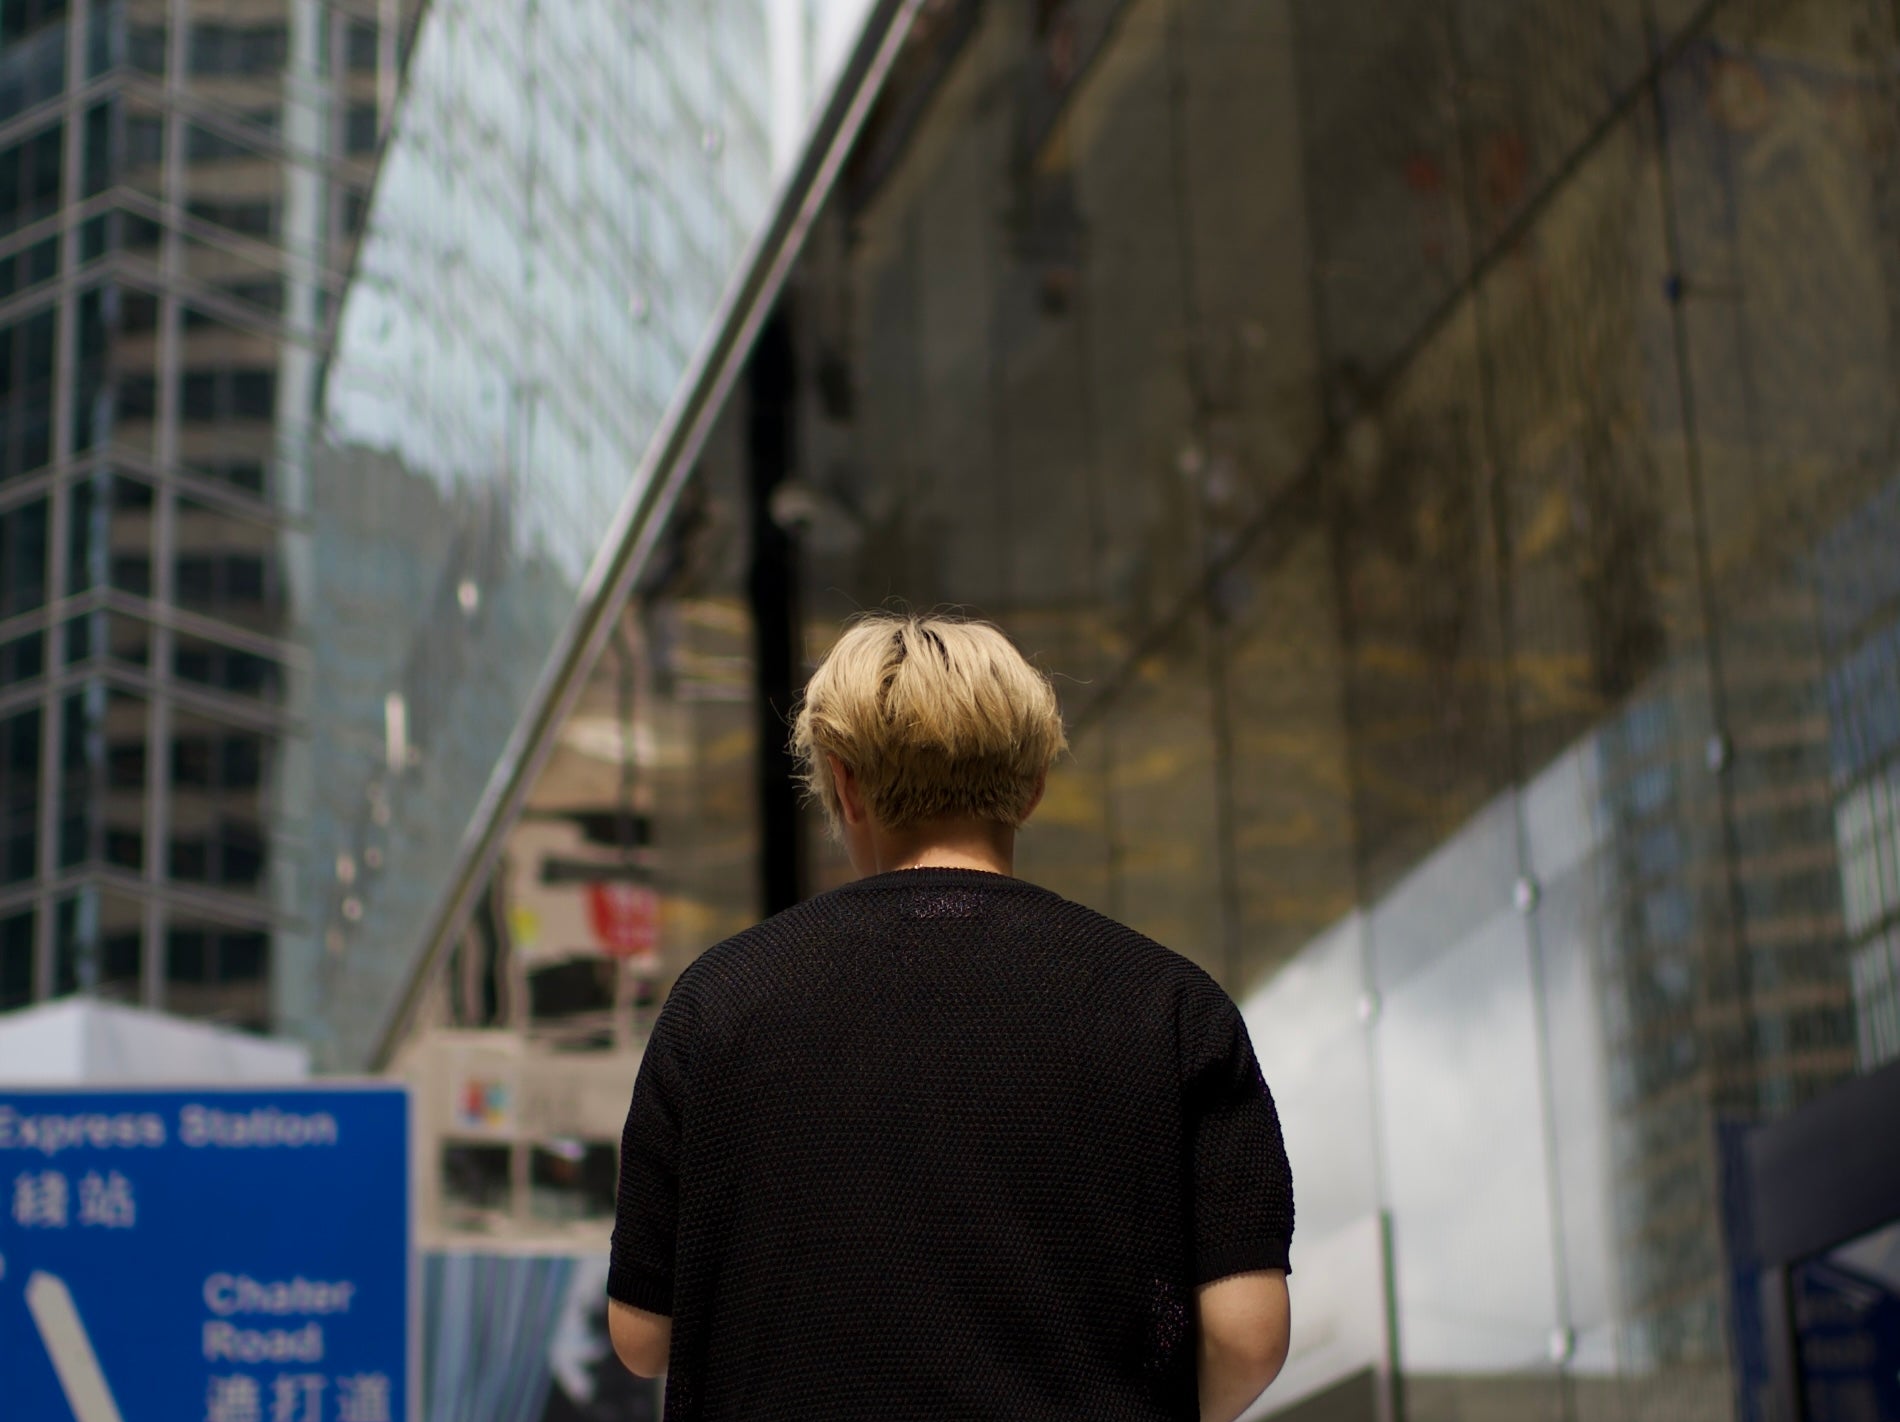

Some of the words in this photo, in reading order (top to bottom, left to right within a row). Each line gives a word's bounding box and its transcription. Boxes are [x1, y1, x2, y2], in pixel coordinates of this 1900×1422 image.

[179, 1104, 338, 1148] Station
[203, 1272, 354, 1316] Chater
[202, 1320, 323, 1363] Road
